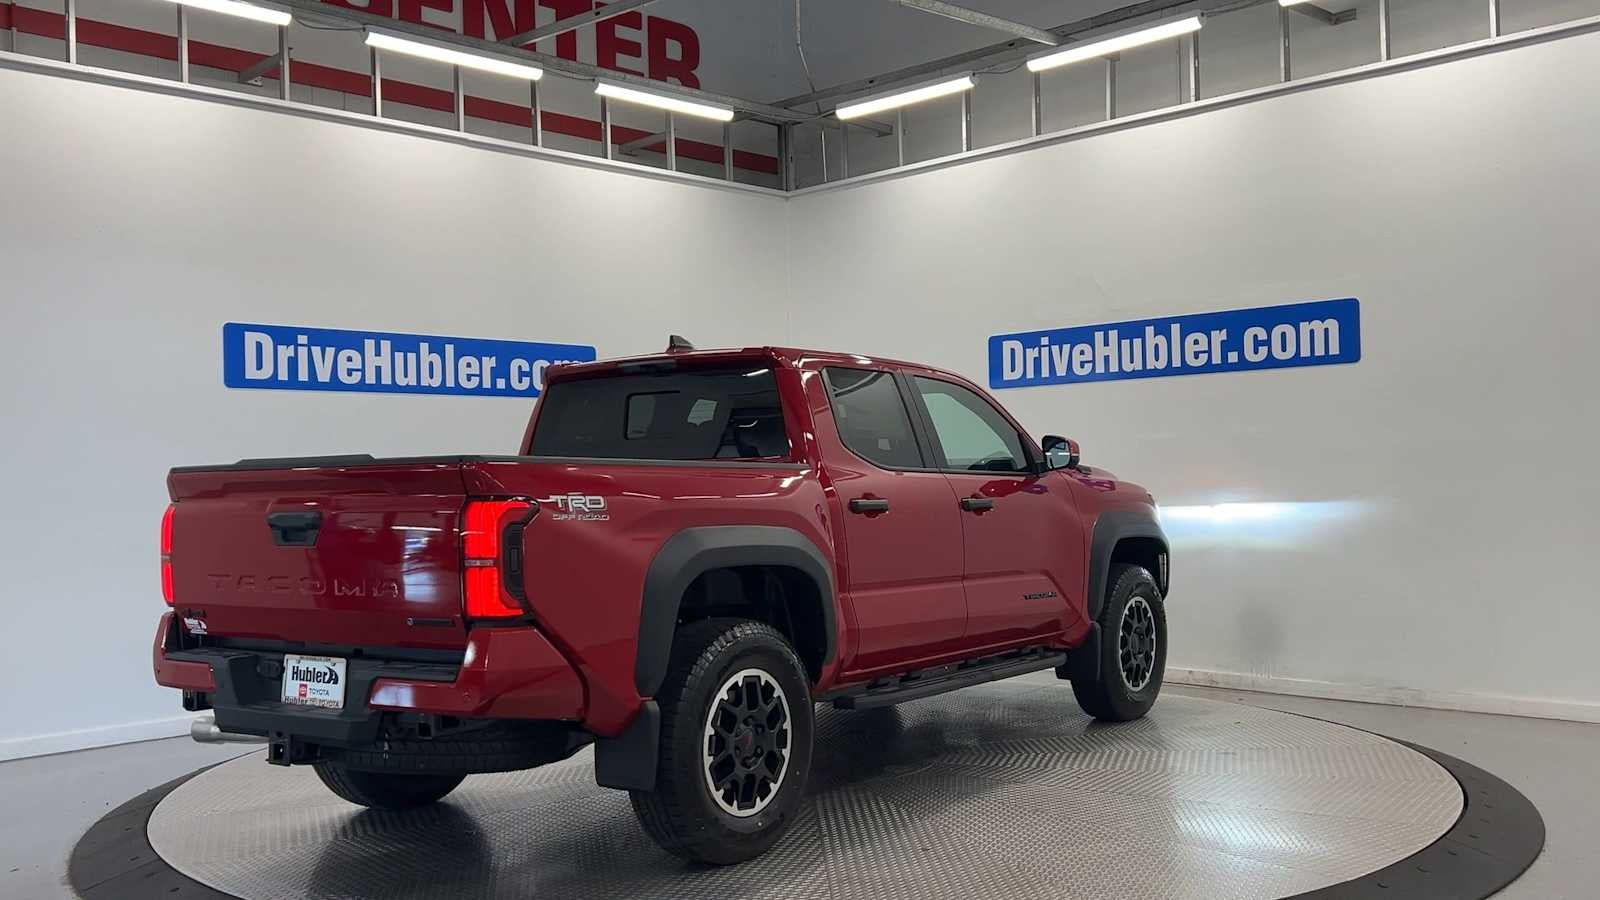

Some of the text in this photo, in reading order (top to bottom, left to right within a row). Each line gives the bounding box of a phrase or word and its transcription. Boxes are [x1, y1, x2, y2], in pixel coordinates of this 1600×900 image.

[320, 0, 700, 90] ENTER
[244, 331, 580, 390] DriveHubler.co
[1002, 317, 1340, 381] DriveHubler.com
[549, 493, 606, 512] TRD
[207, 573, 399, 598] TACOMA
[291, 665, 328, 683] Hubler
[309, 687, 330, 696] TOYOTA
